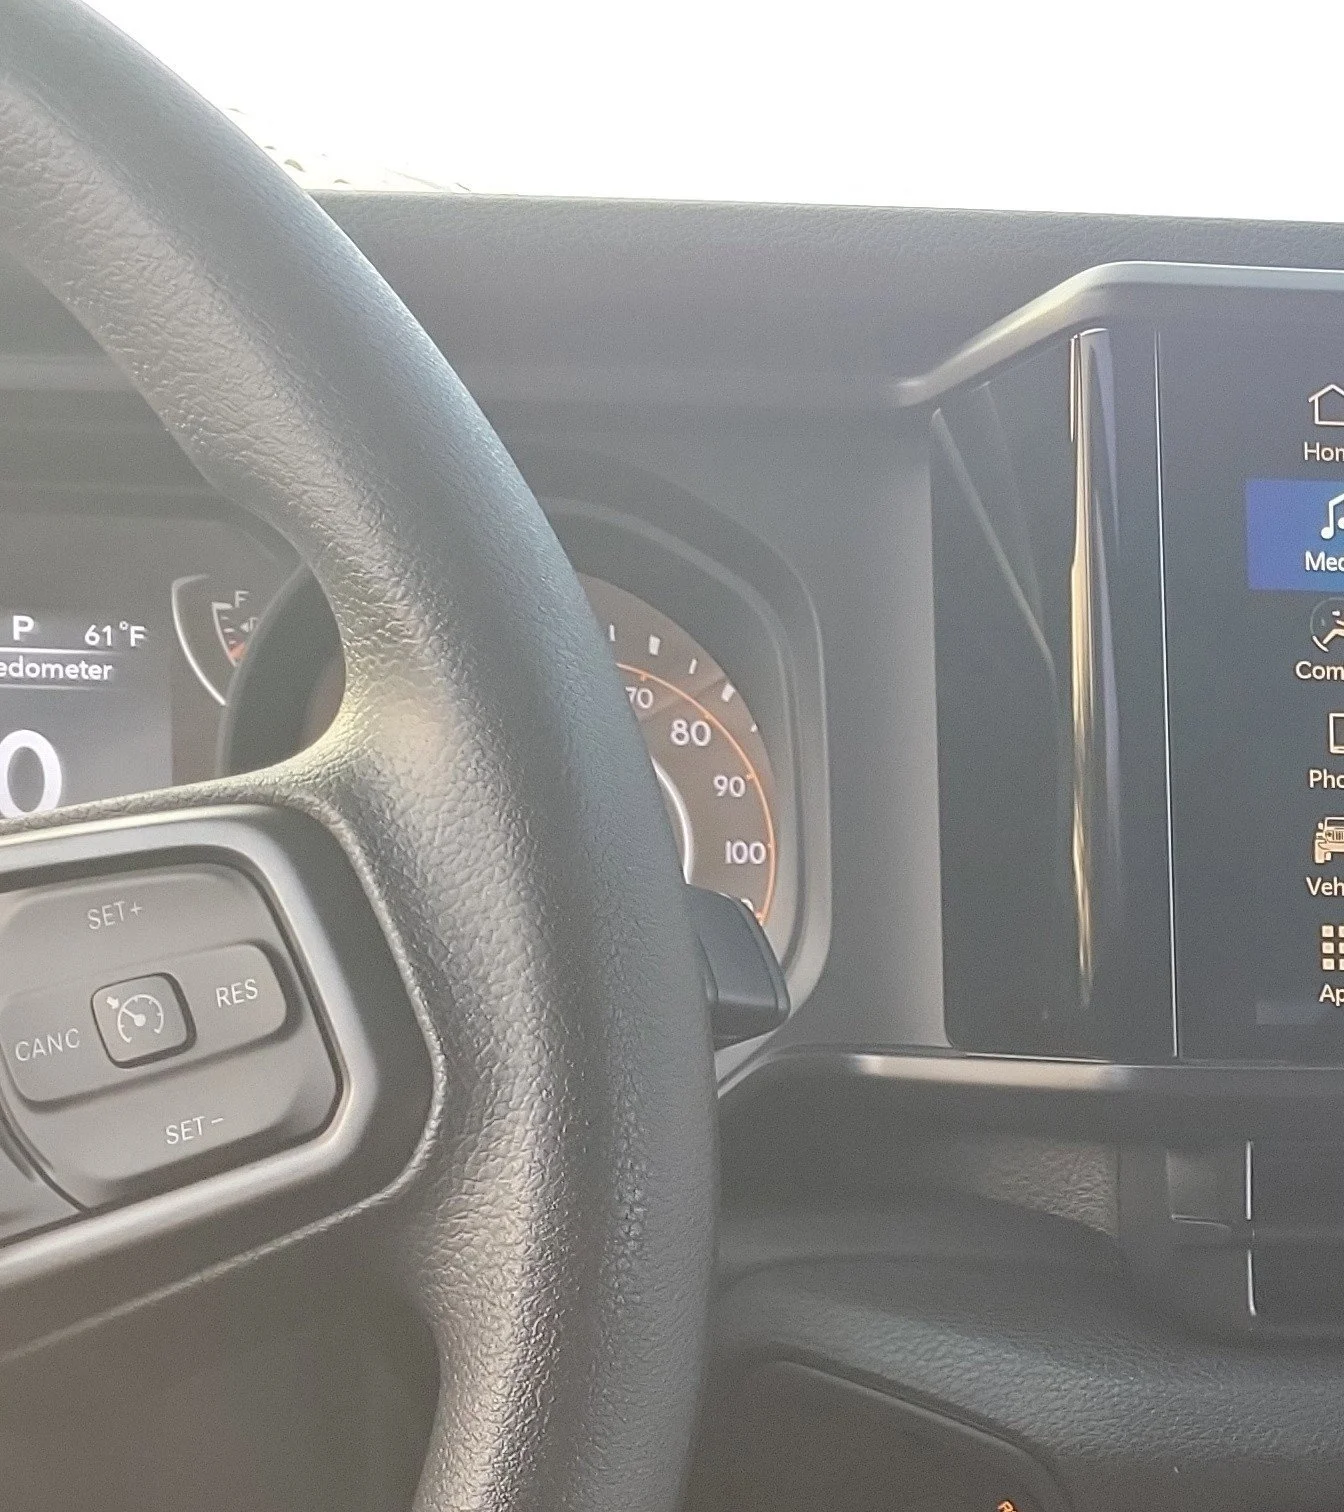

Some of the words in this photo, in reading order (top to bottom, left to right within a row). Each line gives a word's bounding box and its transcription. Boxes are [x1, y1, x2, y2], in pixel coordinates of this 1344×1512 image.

[12, 615, 35, 641] P
[670, 719, 712, 746] 80
[0, 729, 62, 820] 0
[713, 775, 746, 798] 90
[725, 840, 767, 865] 100
[216, 979, 259, 1008] RES
[15, 1028, 81, 1062] CANC
